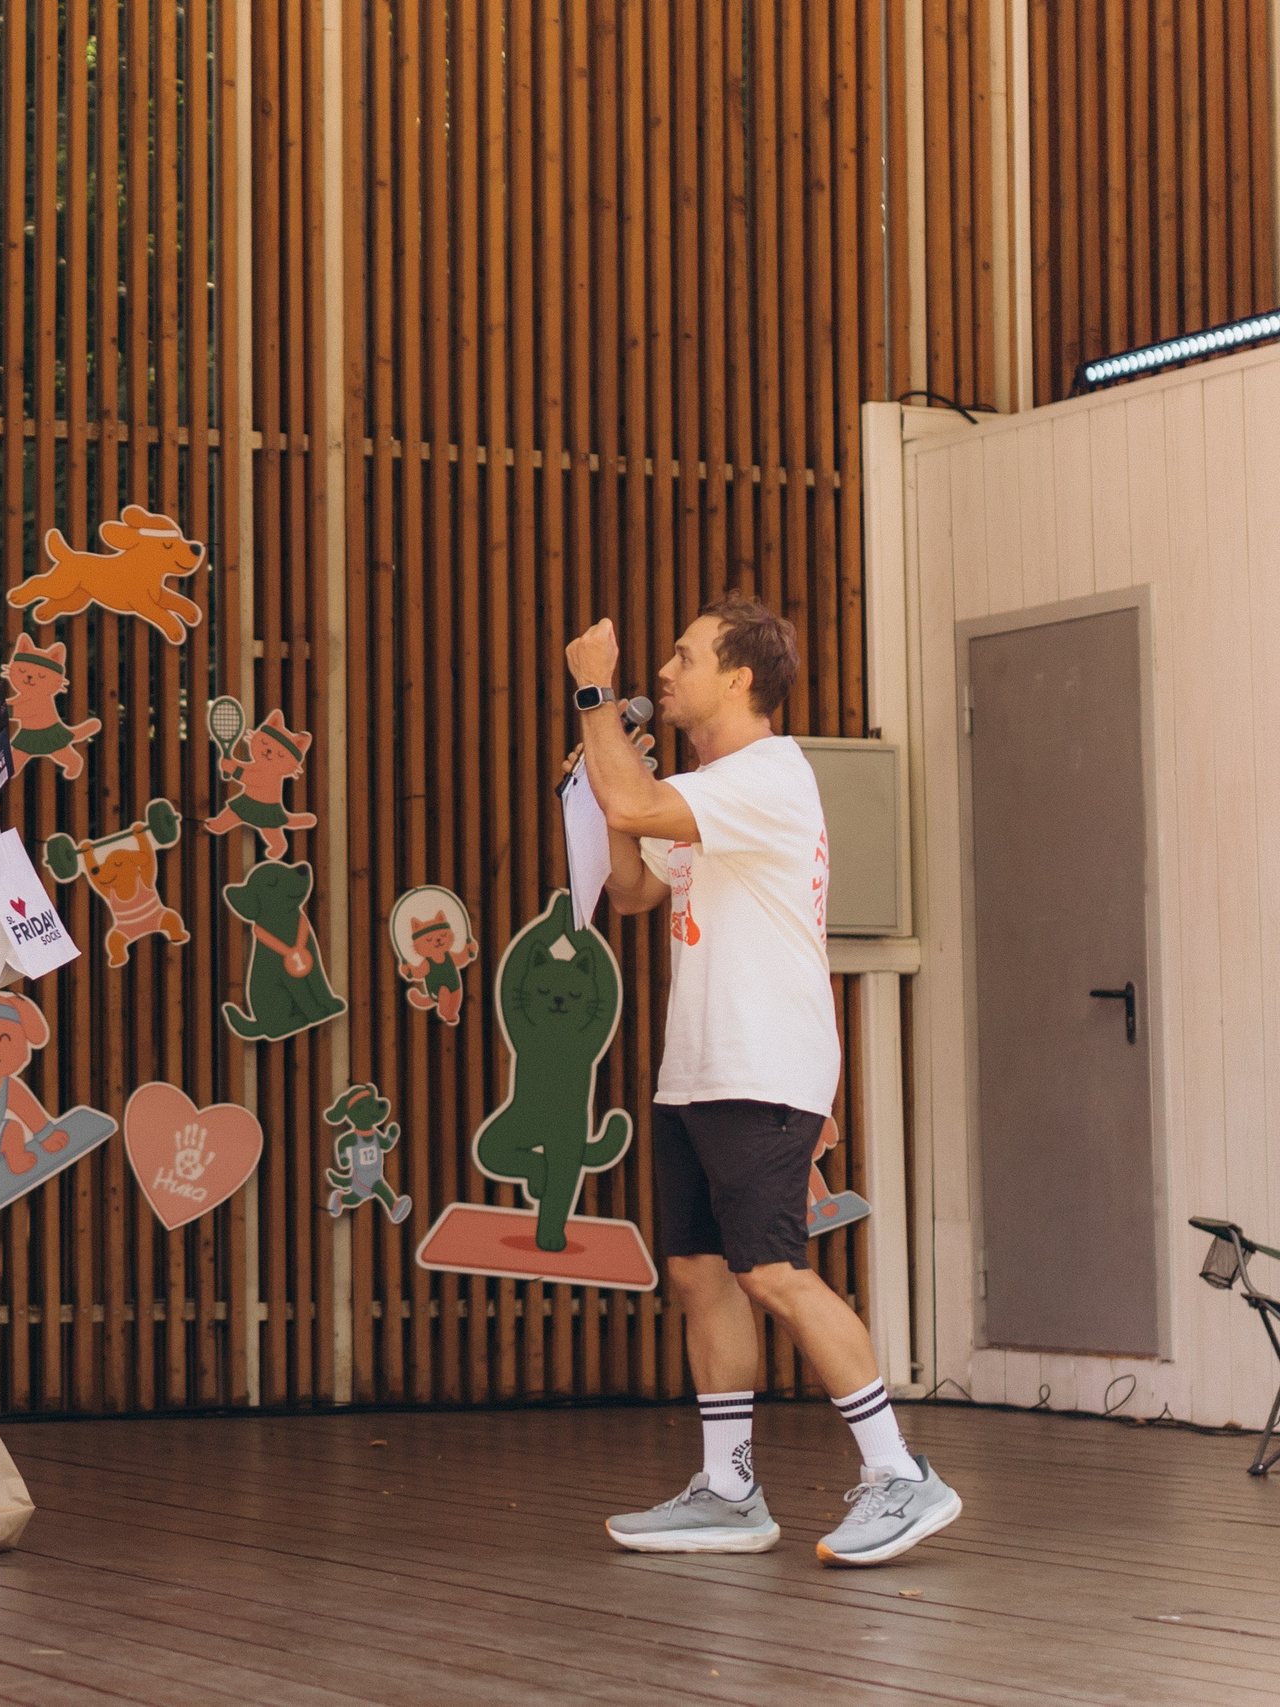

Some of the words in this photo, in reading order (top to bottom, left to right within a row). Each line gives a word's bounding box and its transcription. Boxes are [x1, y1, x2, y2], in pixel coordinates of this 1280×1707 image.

[11, 909, 57, 946] FRIDAY
[40, 929, 62, 946] SOCKS
[292, 951, 307, 972] 1
[363, 1150, 375, 1162] 12
